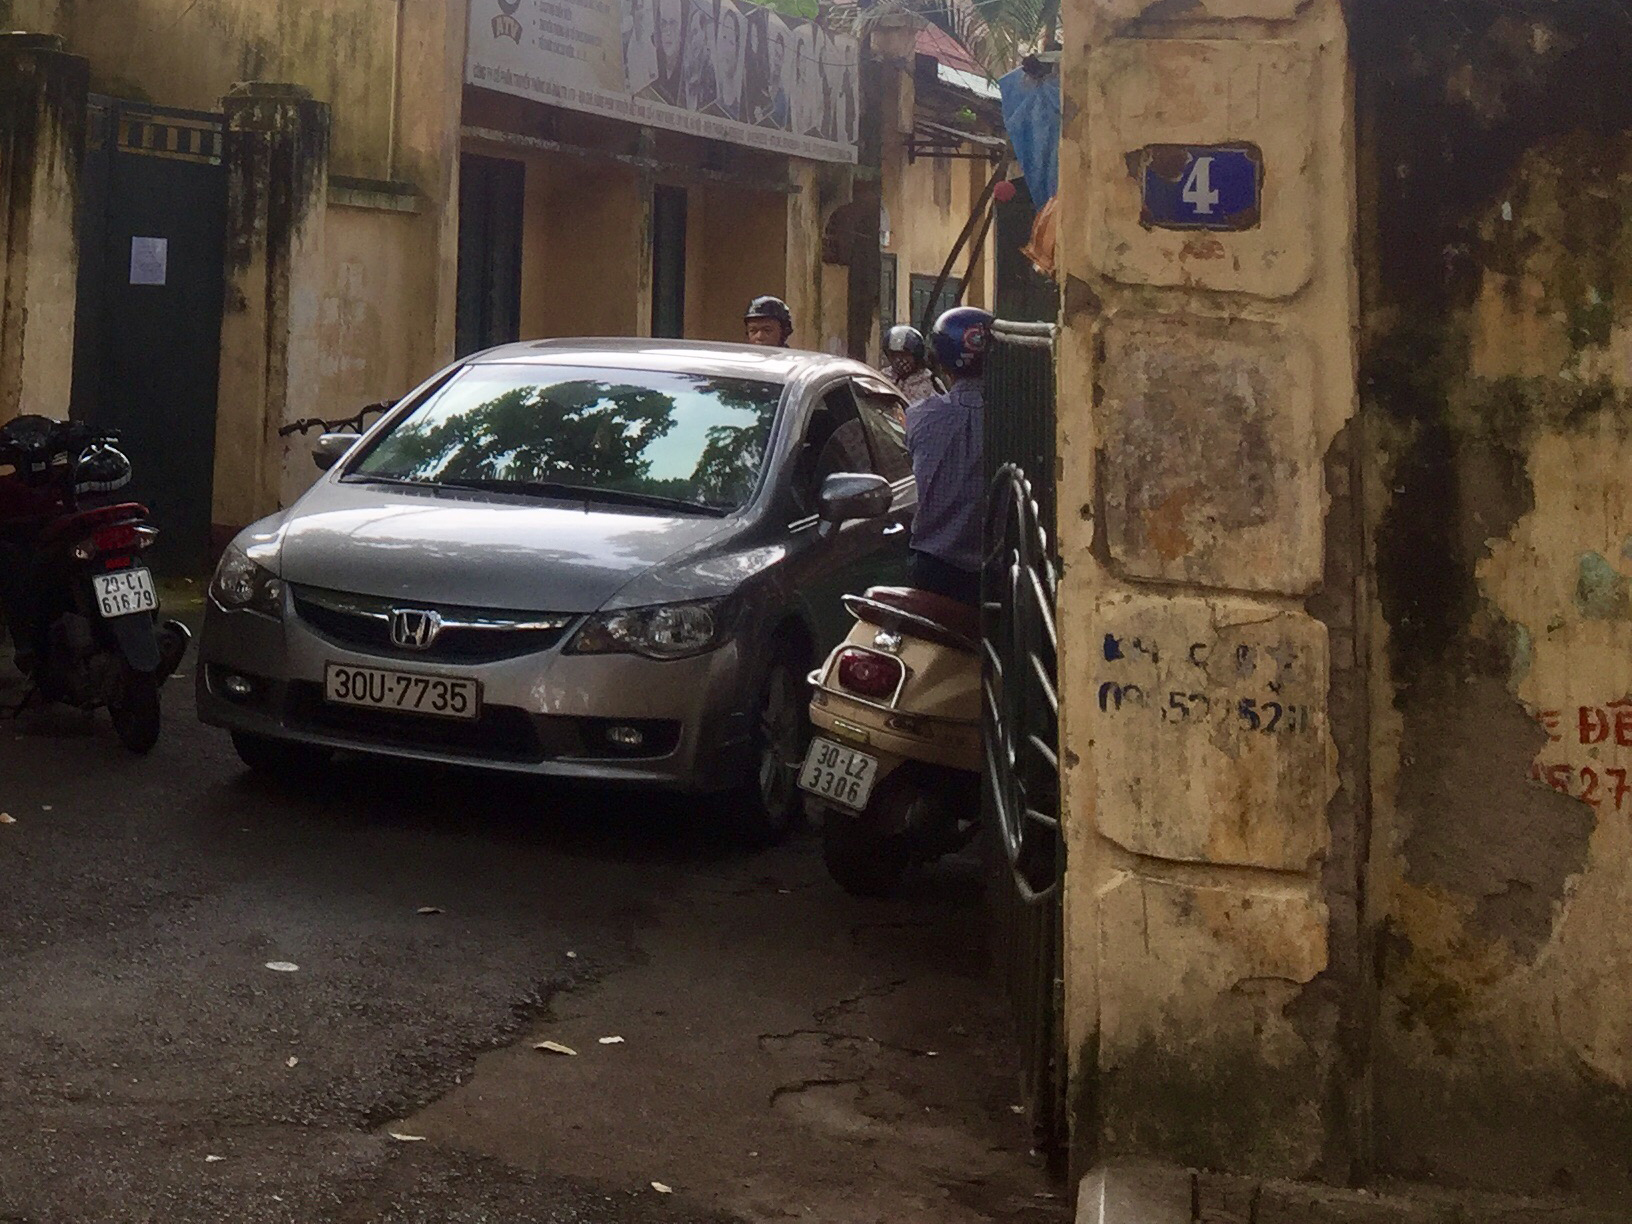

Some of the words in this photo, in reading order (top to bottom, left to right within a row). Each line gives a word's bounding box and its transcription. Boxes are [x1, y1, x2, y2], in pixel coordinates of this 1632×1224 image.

[1182, 156, 1220, 214] 4
[334, 668, 469, 714] 30U-7735
[808, 766, 861, 803] 3306
